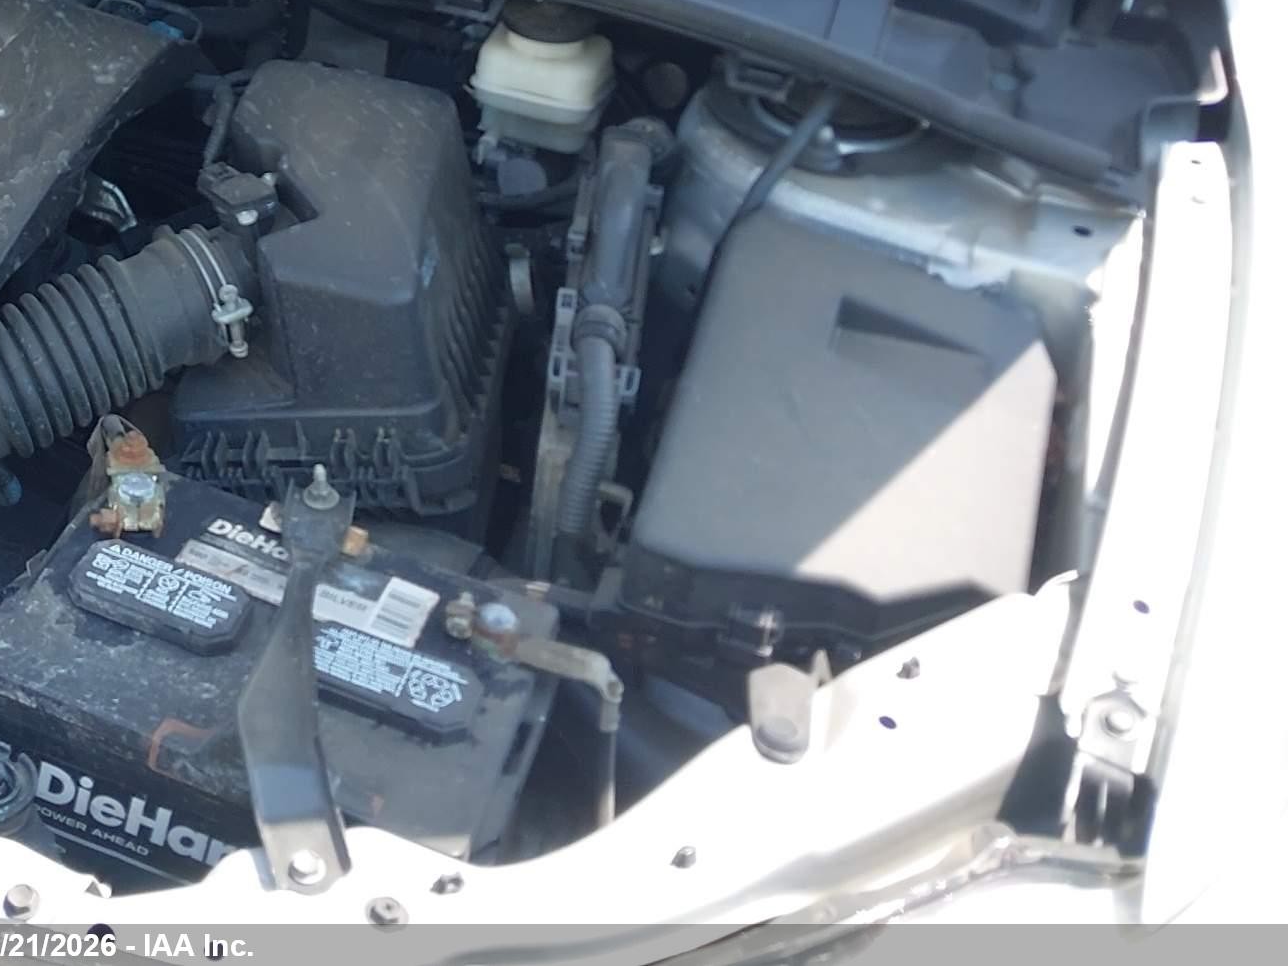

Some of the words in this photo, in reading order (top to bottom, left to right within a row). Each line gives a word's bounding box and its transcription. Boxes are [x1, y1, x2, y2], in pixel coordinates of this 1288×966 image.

[122, 546, 174, 572] DANGER
[184, 570, 232, 594] POISON
[92, 828, 149, 856] AHEAD
